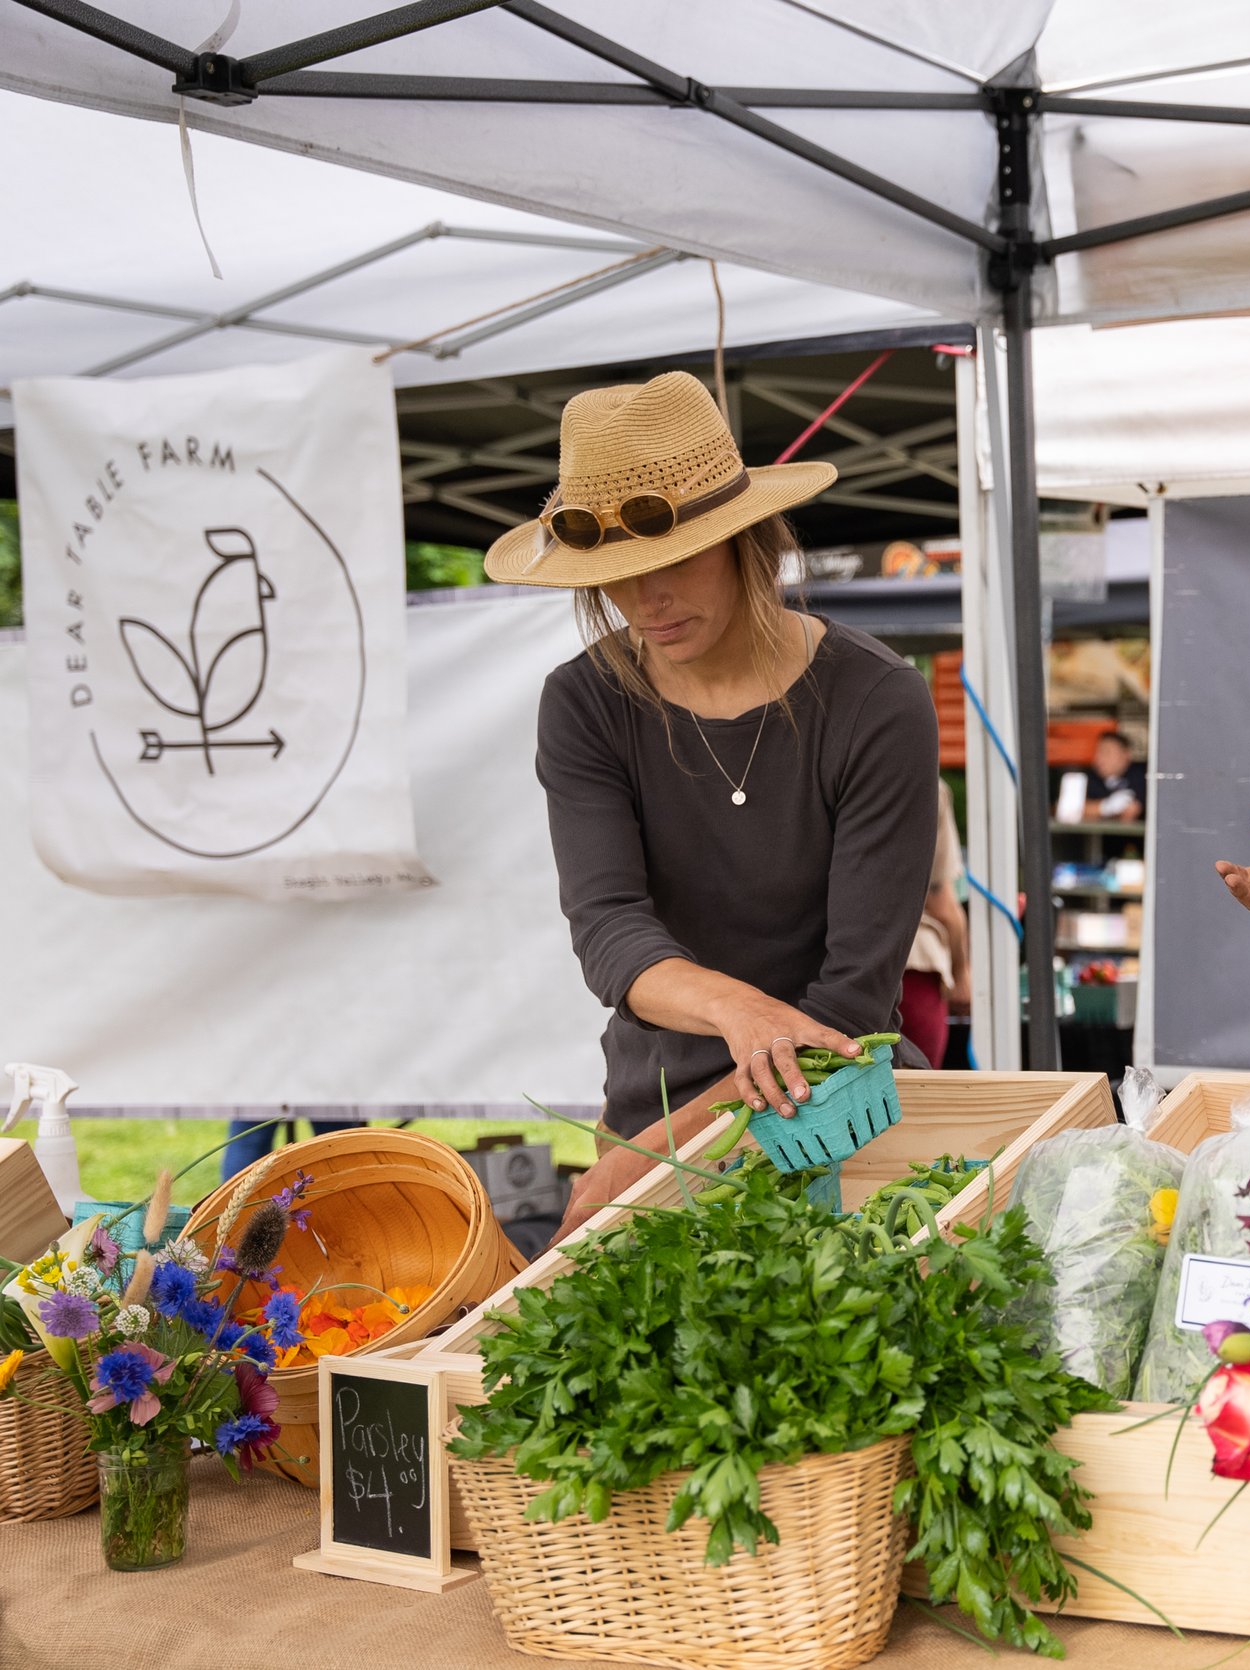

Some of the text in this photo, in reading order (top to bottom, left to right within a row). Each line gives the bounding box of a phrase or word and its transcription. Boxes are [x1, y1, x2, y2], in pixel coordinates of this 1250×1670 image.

[65, 435, 237, 708] DEAR TABLE FARM
[336, 1386, 425, 1509] Parsley
